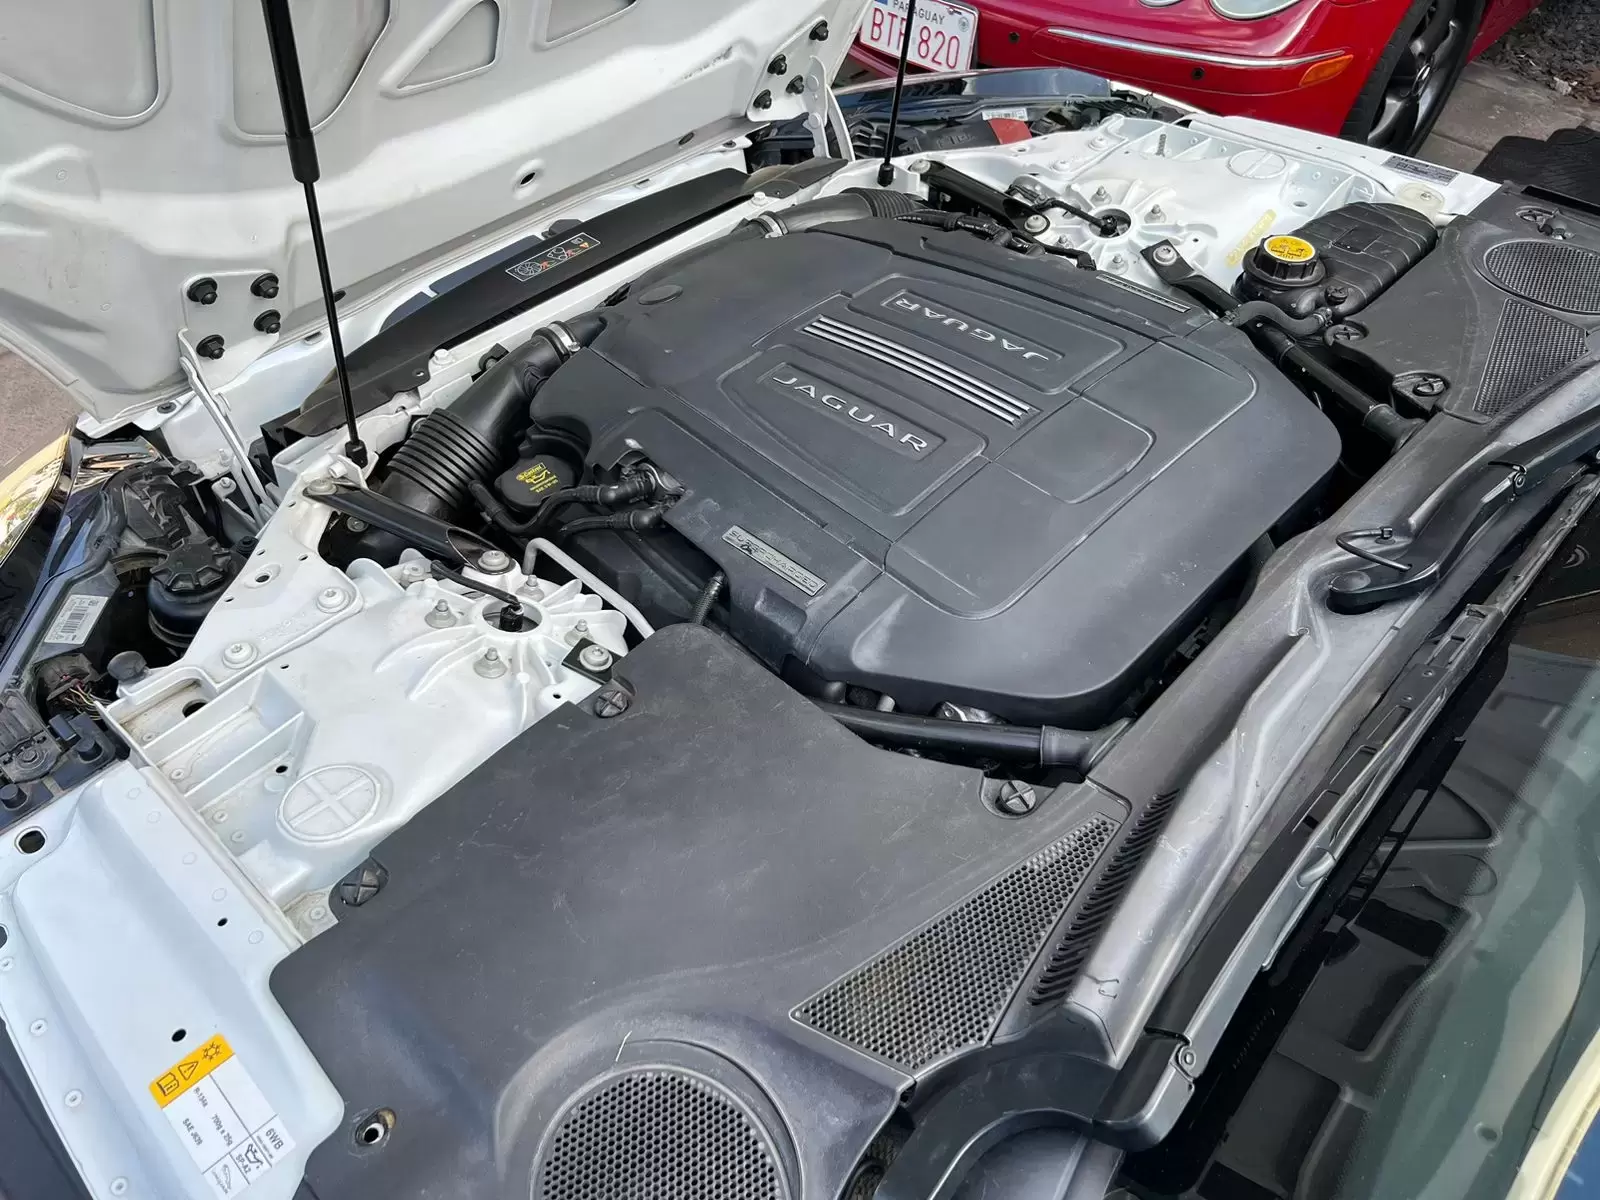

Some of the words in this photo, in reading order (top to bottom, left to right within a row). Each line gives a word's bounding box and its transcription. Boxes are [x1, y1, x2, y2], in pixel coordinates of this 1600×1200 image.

[918, 26, 960, 69] 820
[895, 298, 1049, 361] JAGUAR
[773, 377, 928, 452] JAGUAR
[183, 1118, 194, 1132] SAE
[236, 1154, 252, 1174] SP-A2
